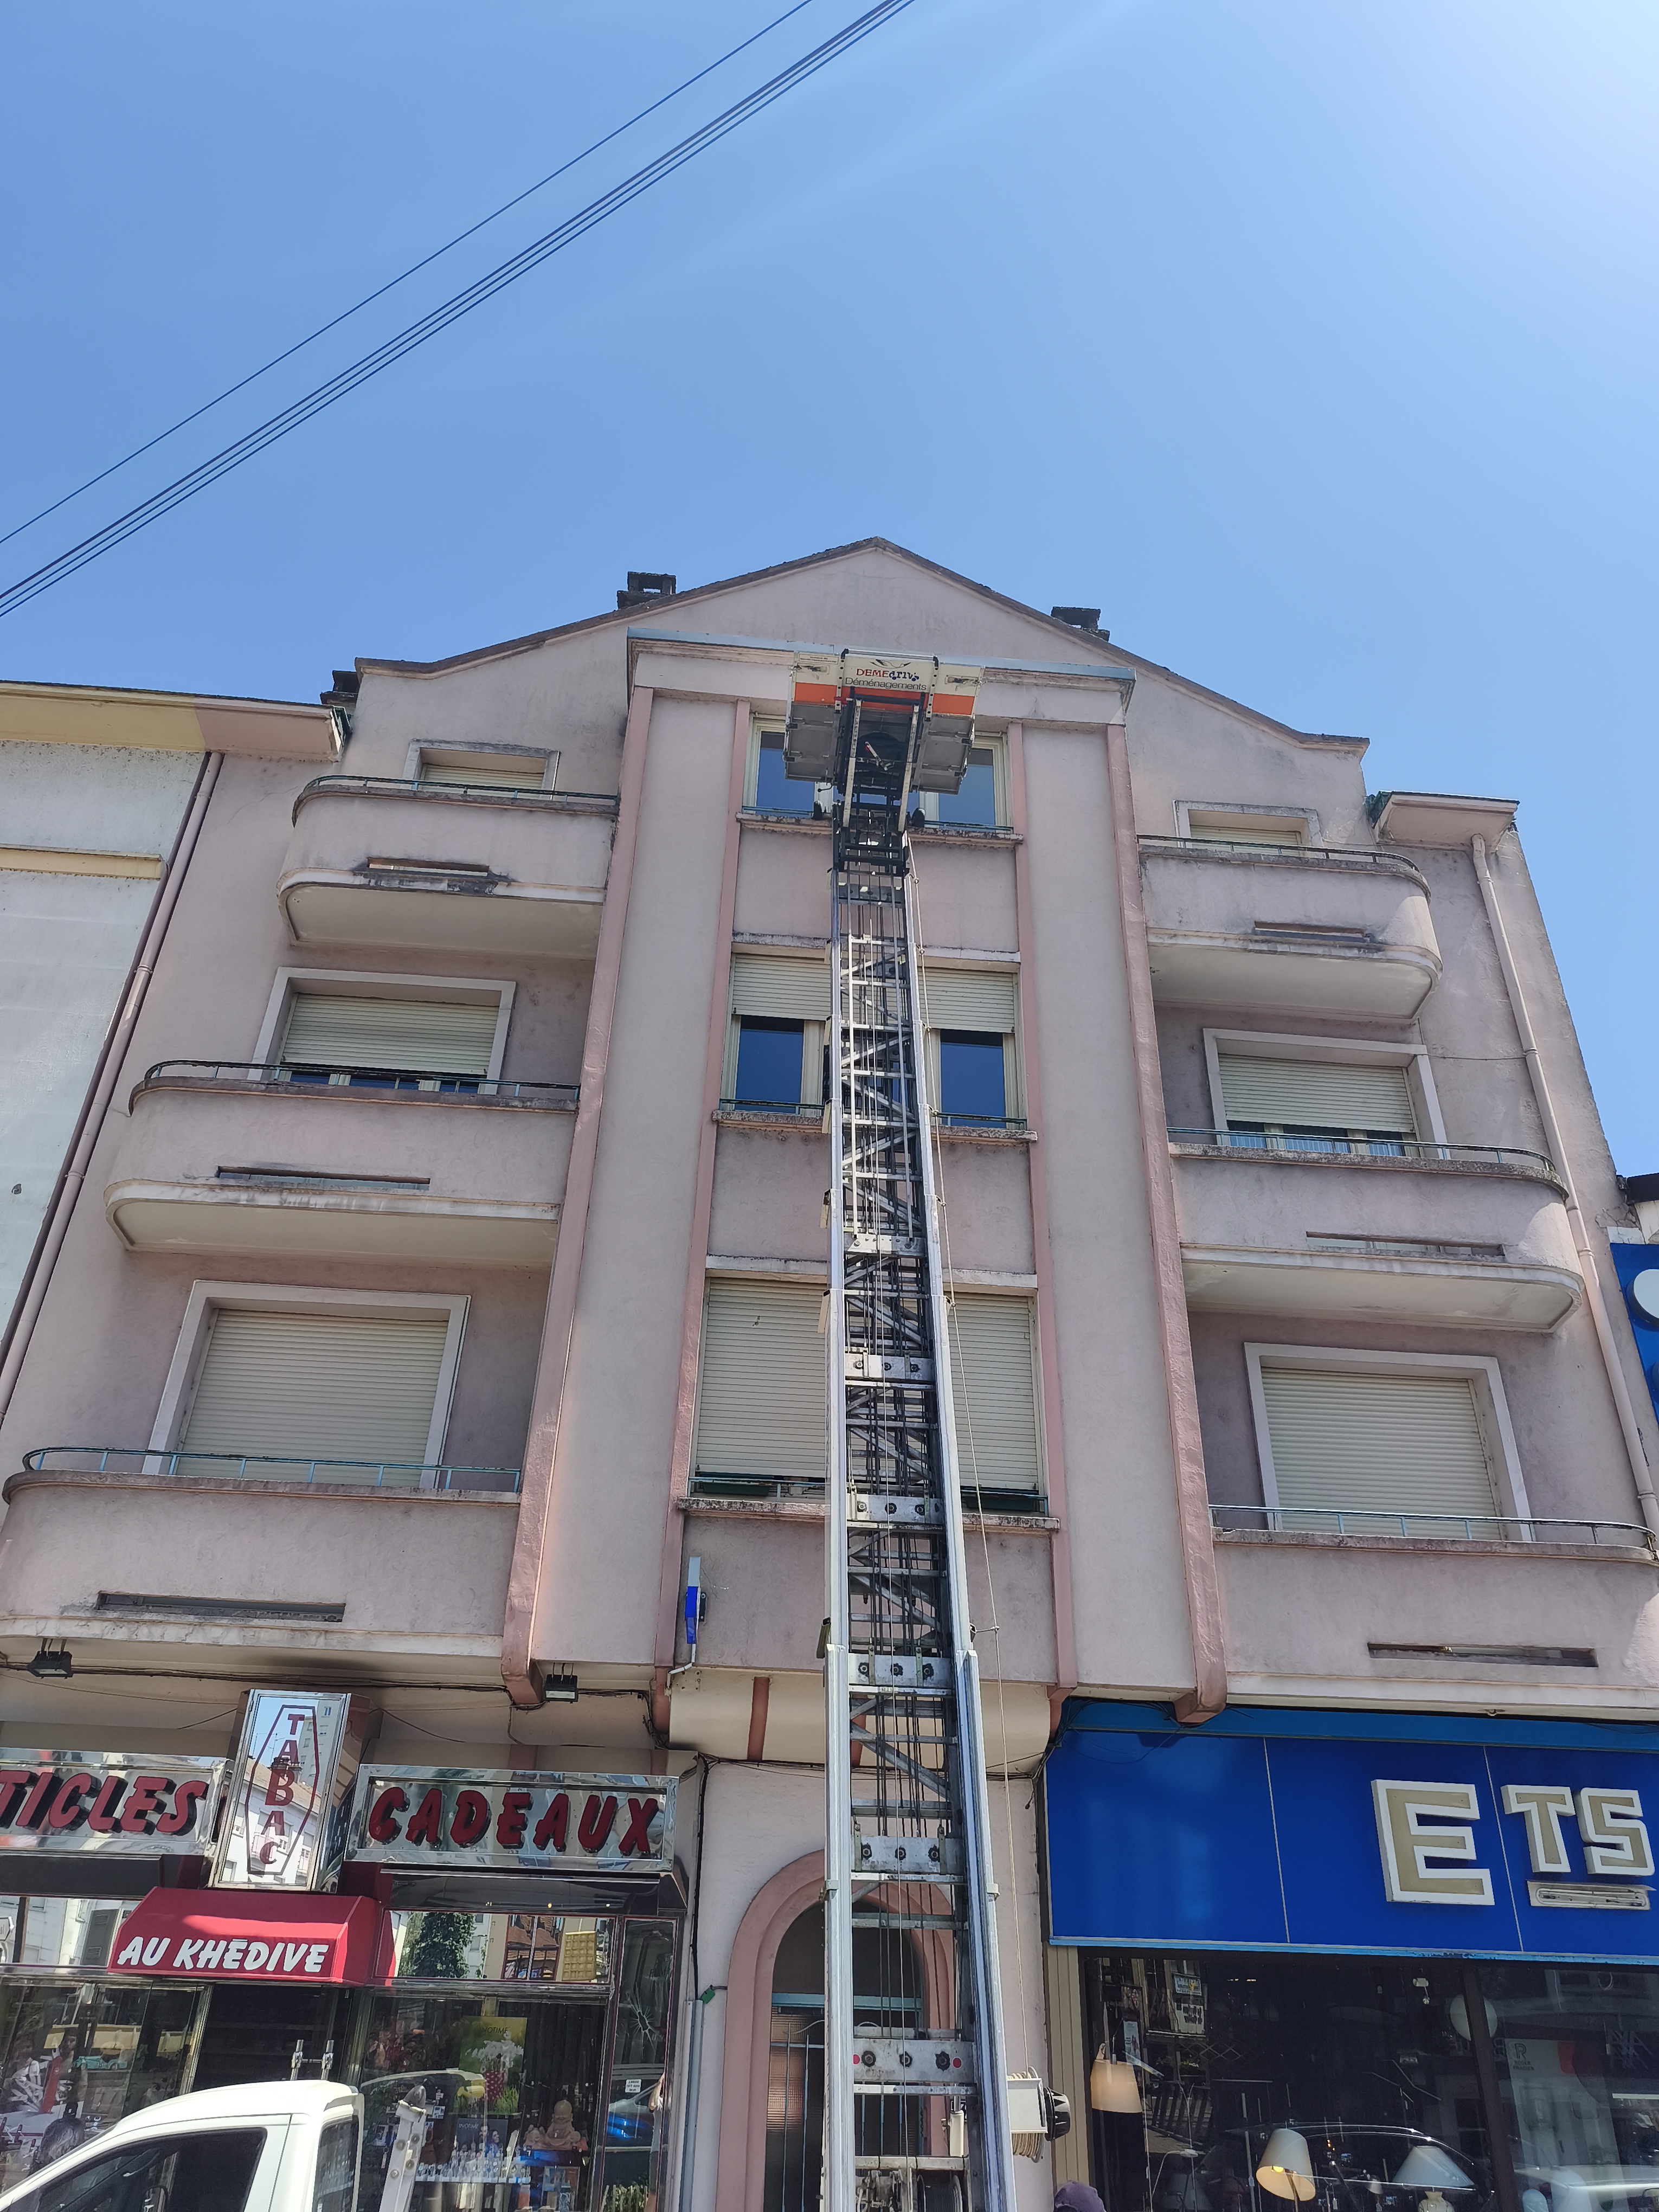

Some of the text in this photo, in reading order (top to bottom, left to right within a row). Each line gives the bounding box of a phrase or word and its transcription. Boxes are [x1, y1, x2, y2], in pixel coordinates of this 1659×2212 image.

[845, 677, 927, 690] Déménagements
[0, 1770, 208, 1834] TICLES
[259, 1713, 305, 1865] TABAC
[369, 1786, 659, 1856] CADEAUX
[1371, 1779, 1655, 1905] ETS
[117, 1936, 171, 1966] AU
